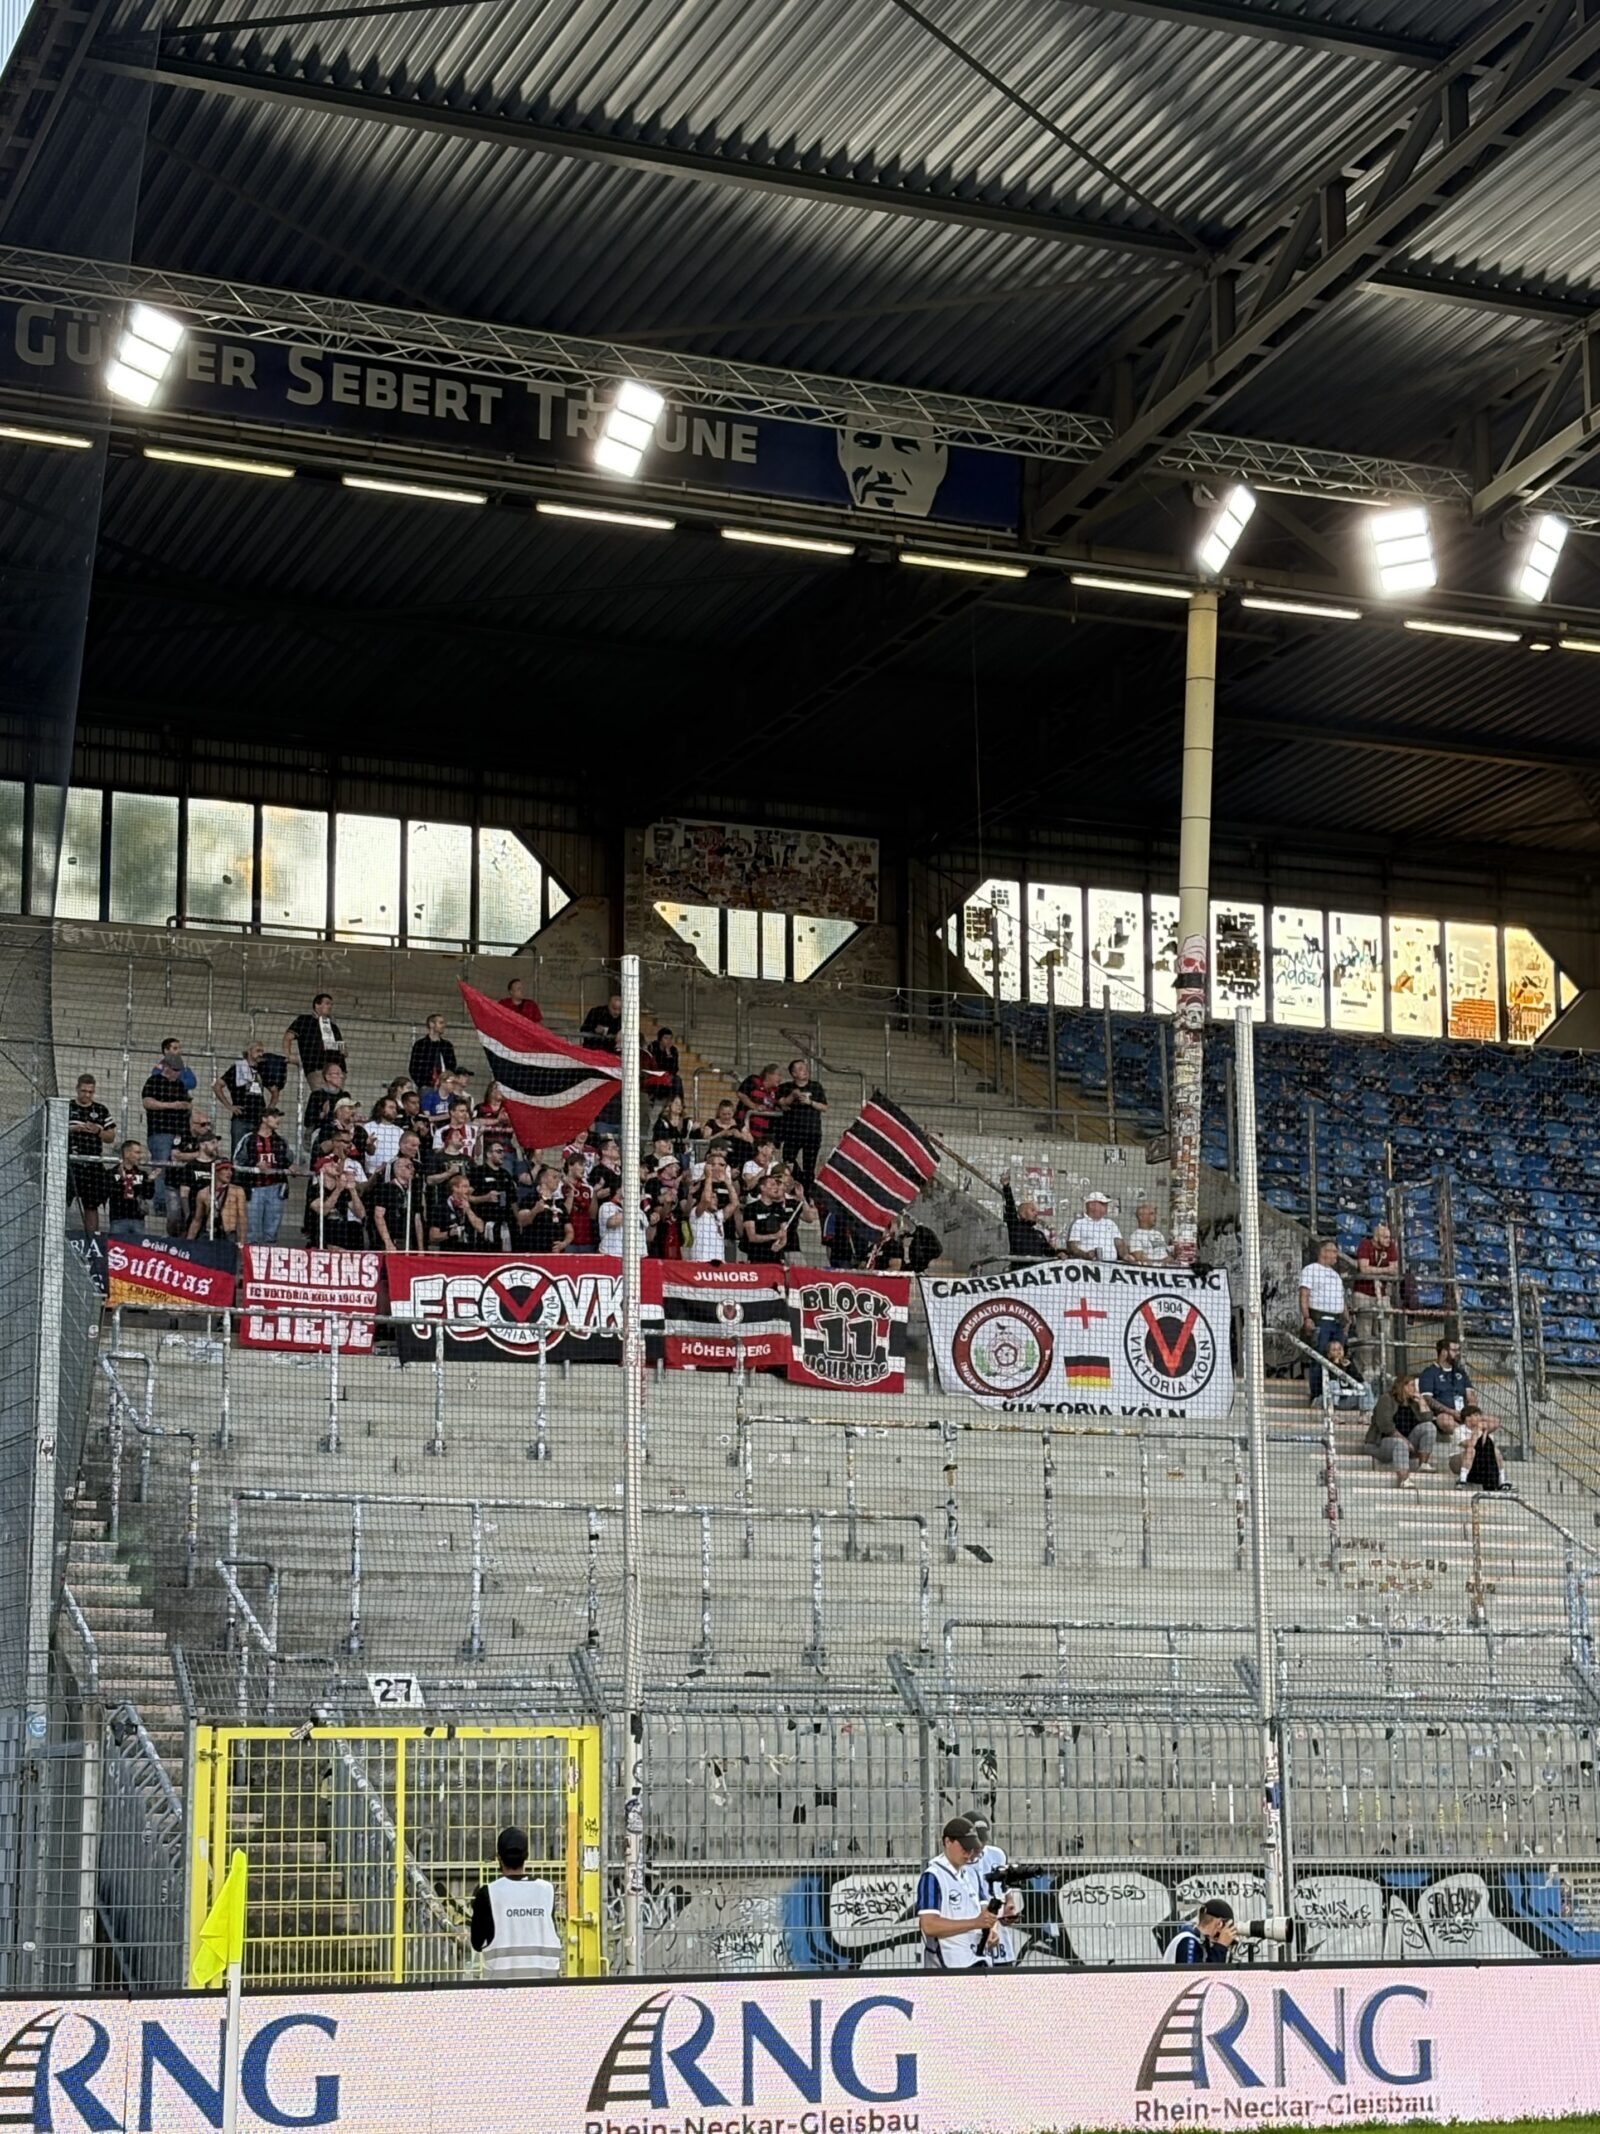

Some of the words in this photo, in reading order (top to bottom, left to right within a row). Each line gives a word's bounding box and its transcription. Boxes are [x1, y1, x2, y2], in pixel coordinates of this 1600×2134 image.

[286, 350, 503, 425] SEBERT
[527, 382, 758, 464] TRÜNE
[248, 1245, 379, 1288] VEREINS
[509, 1271, 532, 1285] FC
[693, 1271, 759, 1283] JUNIORS
[932, 1264, 1101, 1299] CARSHALTON
[1109, 1268, 1221, 1291] ATHLETIC
[250, 1286, 262, 1298] FC
[801, 1283, 891, 1319] BLOCK
[1157, 1301, 1183, 1315] 1904
[816, 1314, 877, 1360] 11
[959, 1303, 1007, 1343] CARSHALTON
[1008, 1304, 1045, 1334] ATHLETIC
[681, 1342, 771, 1358] HÖHENERG
[1130, 1335, 1188, 1396] VIKTORIA
[1190, 1339, 1211, 1385] KÖLN
[803, 1352, 889, 1383] HÖHENBERG
[374, 1678, 413, 1702] 27
[505, 1907, 545, 1918] ORDNER
[640, 1992, 919, 2108] RNG
[1187, 1980, 1434, 2090] RNG
[30, 2012, 341, 2134] RNG
[585, 2109, 920, 2134] Rhein-Neckar-Gleisbau
[1135, 2093, 1437, 2123] Rhein-Neckar-Gleisbau
